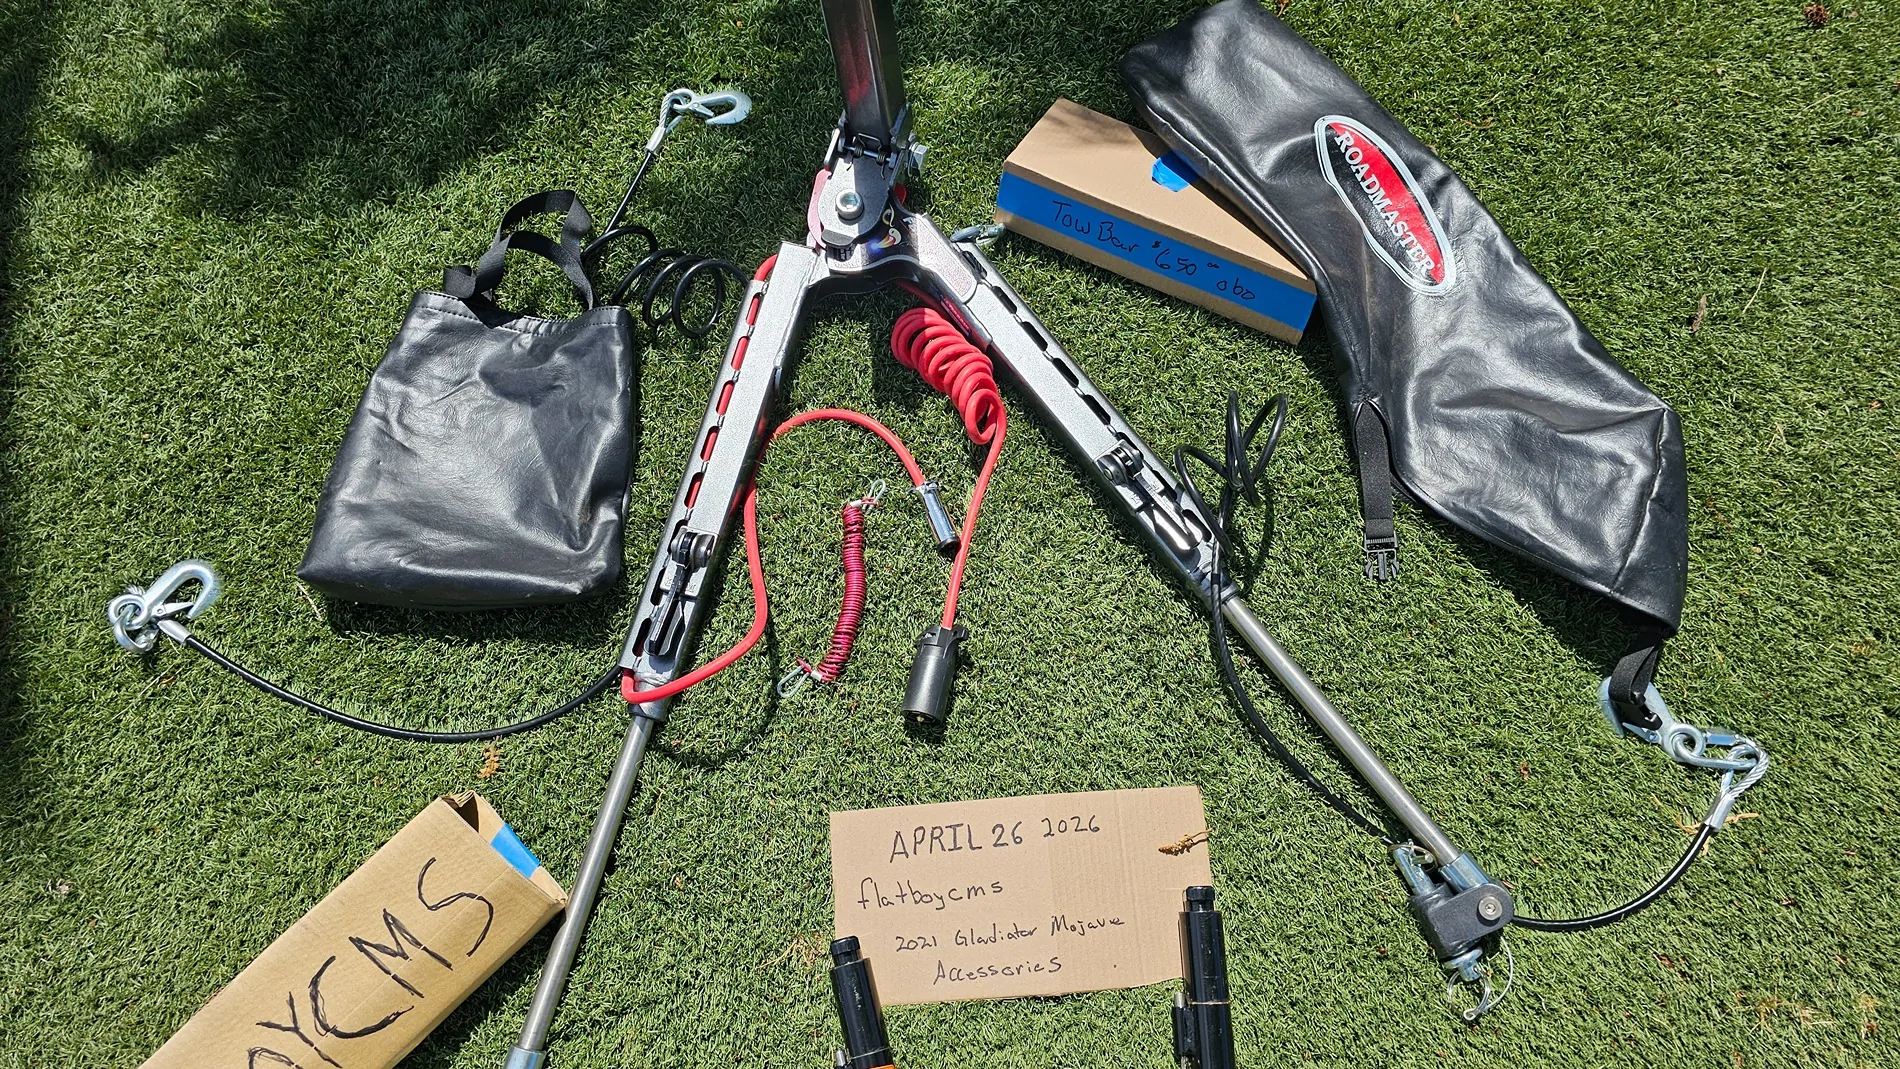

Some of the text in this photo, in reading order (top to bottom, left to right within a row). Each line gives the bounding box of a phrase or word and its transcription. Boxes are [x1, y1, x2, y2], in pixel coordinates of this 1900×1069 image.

[1333, 130, 1436, 277] ROADMASTER
[1052, 200, 1091, 235] Tow
[1097, 221, 1140, 252] Bar
[889, 814, 1101, 864] APRIL 26 2026
[857, 876, 1004, 911] flatboycms
[895, 914, 1126, 953] 2021 Gladiator Mojave
[932, 956, 1063, 986] Accessories
